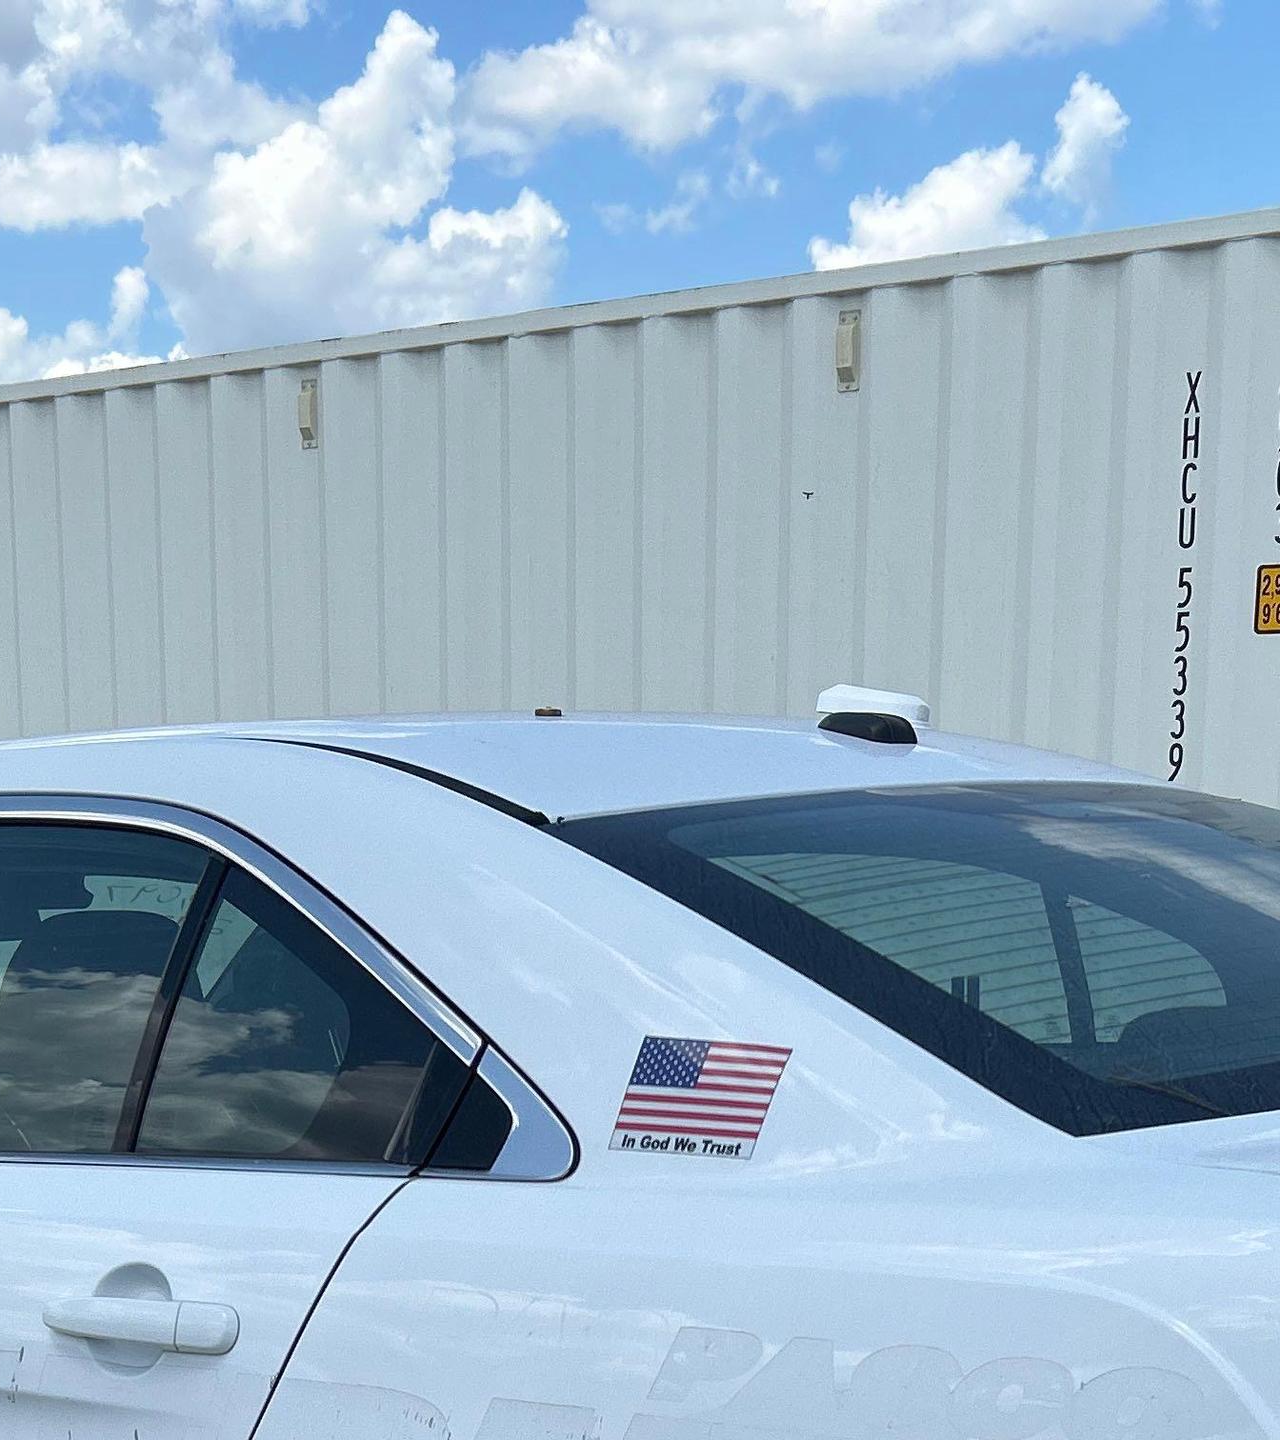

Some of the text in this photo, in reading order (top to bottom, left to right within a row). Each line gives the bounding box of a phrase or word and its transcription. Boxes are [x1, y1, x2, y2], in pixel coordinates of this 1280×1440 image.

[1167, 371, 1203, 782] XHCU 55339
[621, 1134, 742, 1156] In God We Trust
